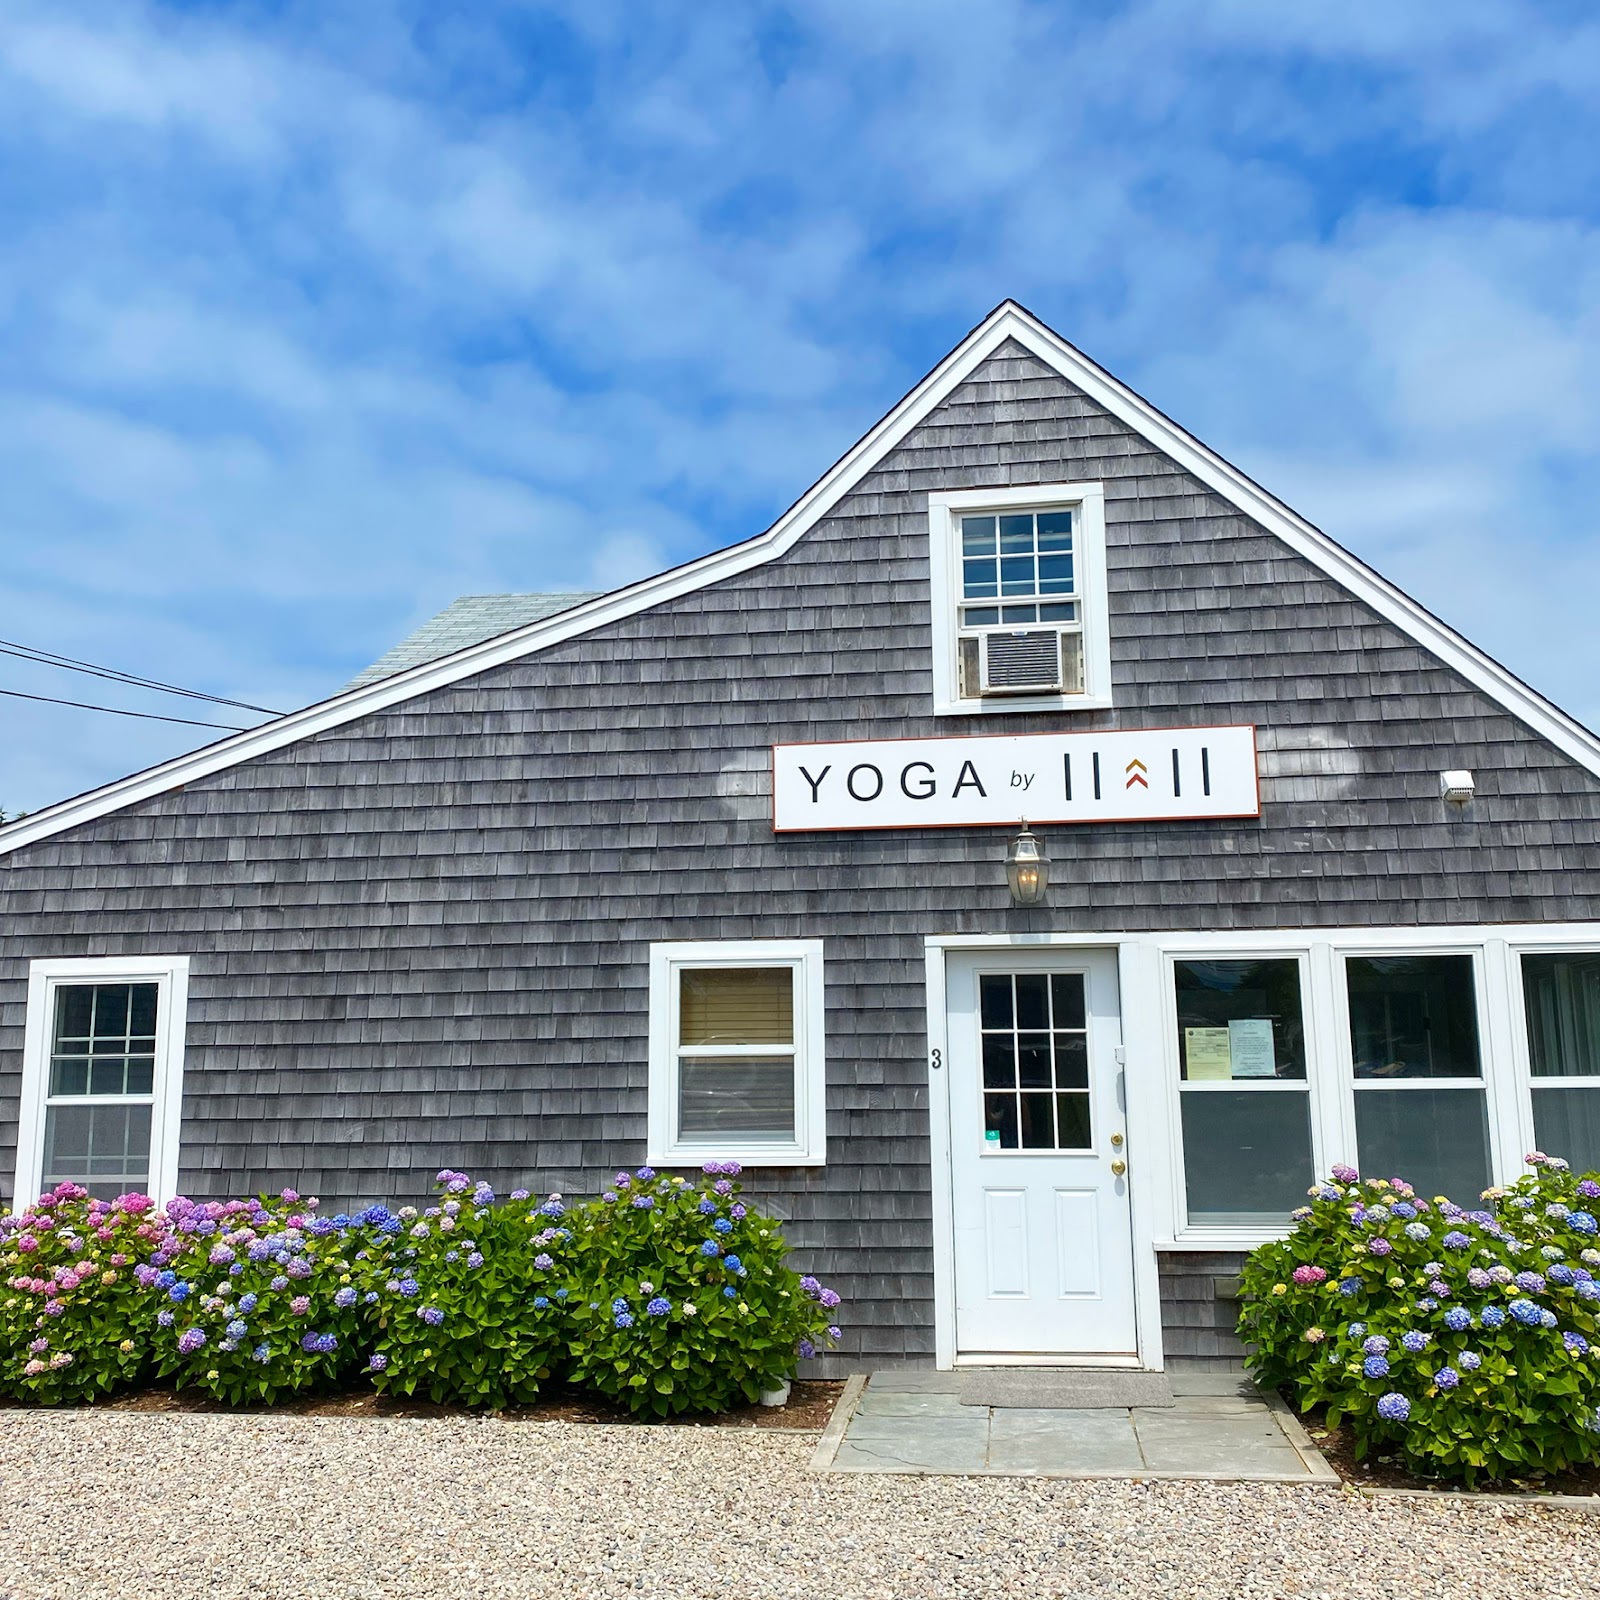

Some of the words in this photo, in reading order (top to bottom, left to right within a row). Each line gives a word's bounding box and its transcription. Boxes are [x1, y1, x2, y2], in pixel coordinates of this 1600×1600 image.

[798, 760, 988, 803] YOGA
[1010, 770, 1035, 790] by
[931, 1048, 942, 1069] 3
